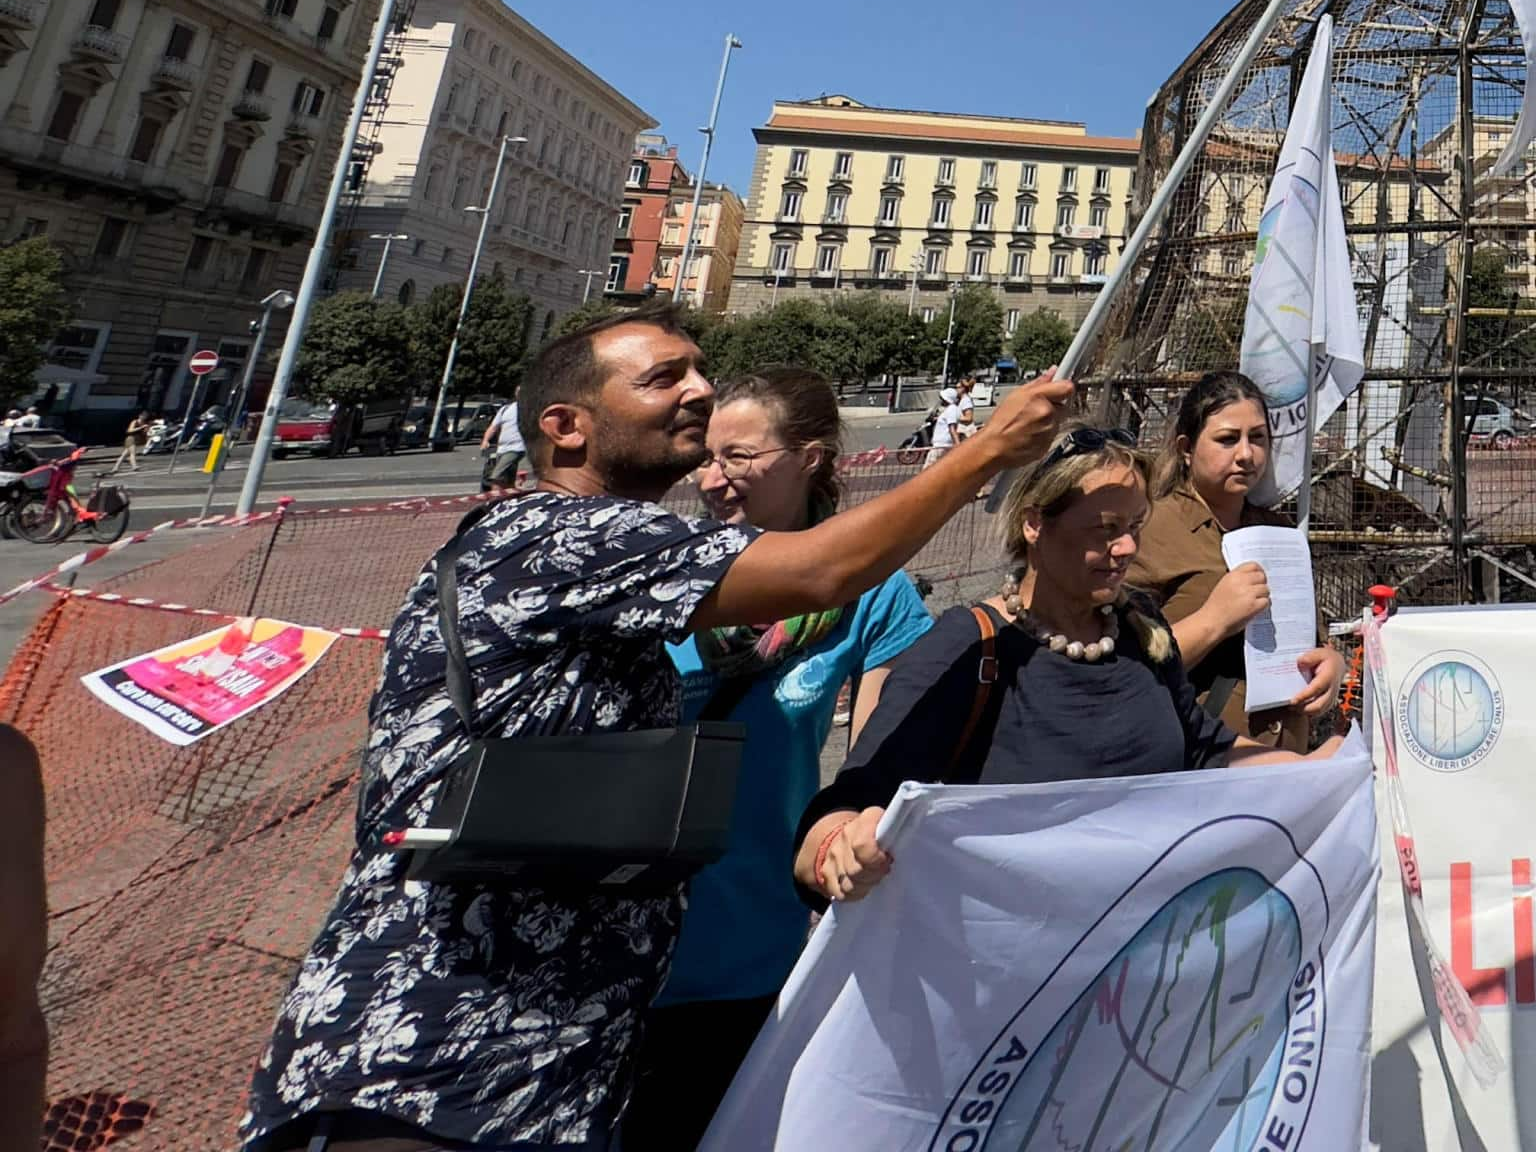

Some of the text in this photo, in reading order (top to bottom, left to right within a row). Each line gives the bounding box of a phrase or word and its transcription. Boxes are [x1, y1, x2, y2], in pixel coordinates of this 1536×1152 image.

[1399, 690, 1503, 770] ASSOCIAZIONE LIBERI DI VOLARE ONLUS
[1282, 960, 1317, 1104] ONLUS
